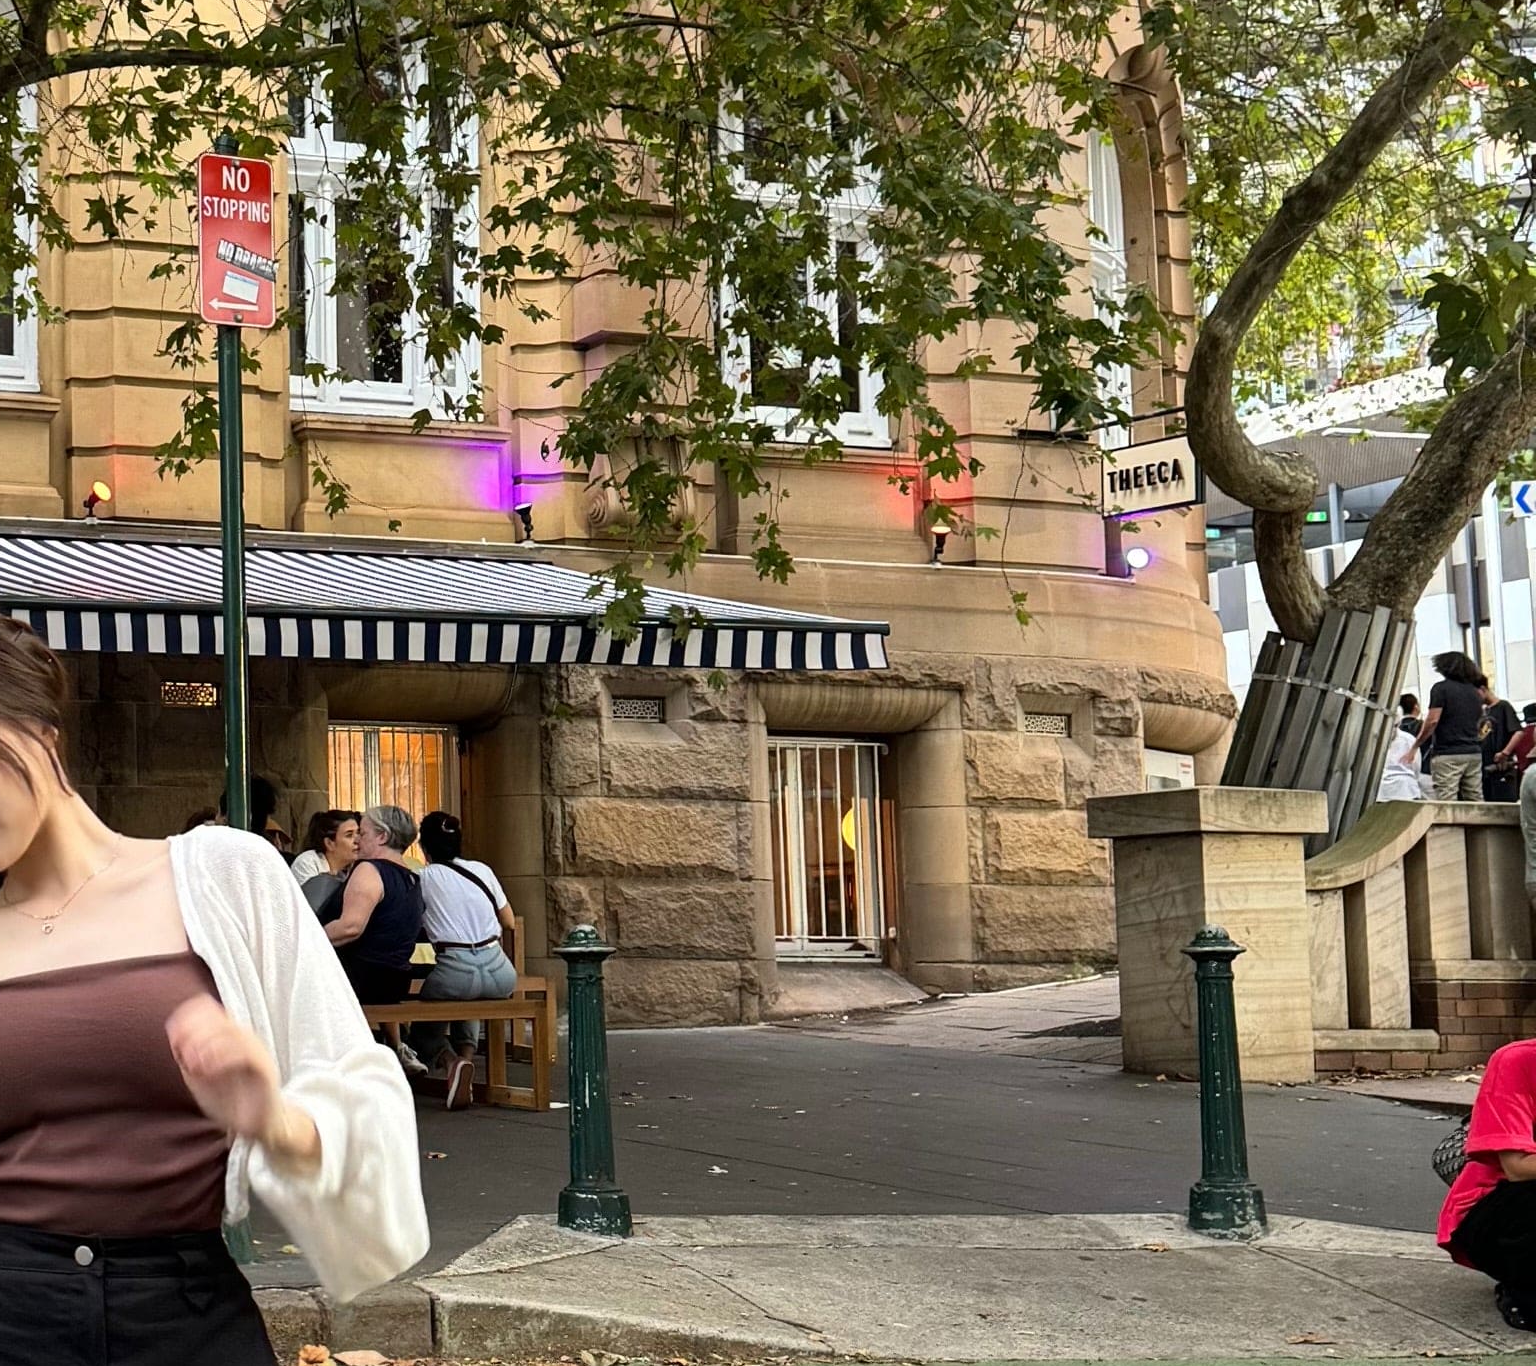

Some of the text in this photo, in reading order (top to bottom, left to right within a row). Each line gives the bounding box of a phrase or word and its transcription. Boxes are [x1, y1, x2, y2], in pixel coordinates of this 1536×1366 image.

[222, 165, 250, 193] NO
[203, 196, 270, 224] STOPPING
[218, 240, 235, 262] NO
[1107, 458, 1185, 493] THEECA
